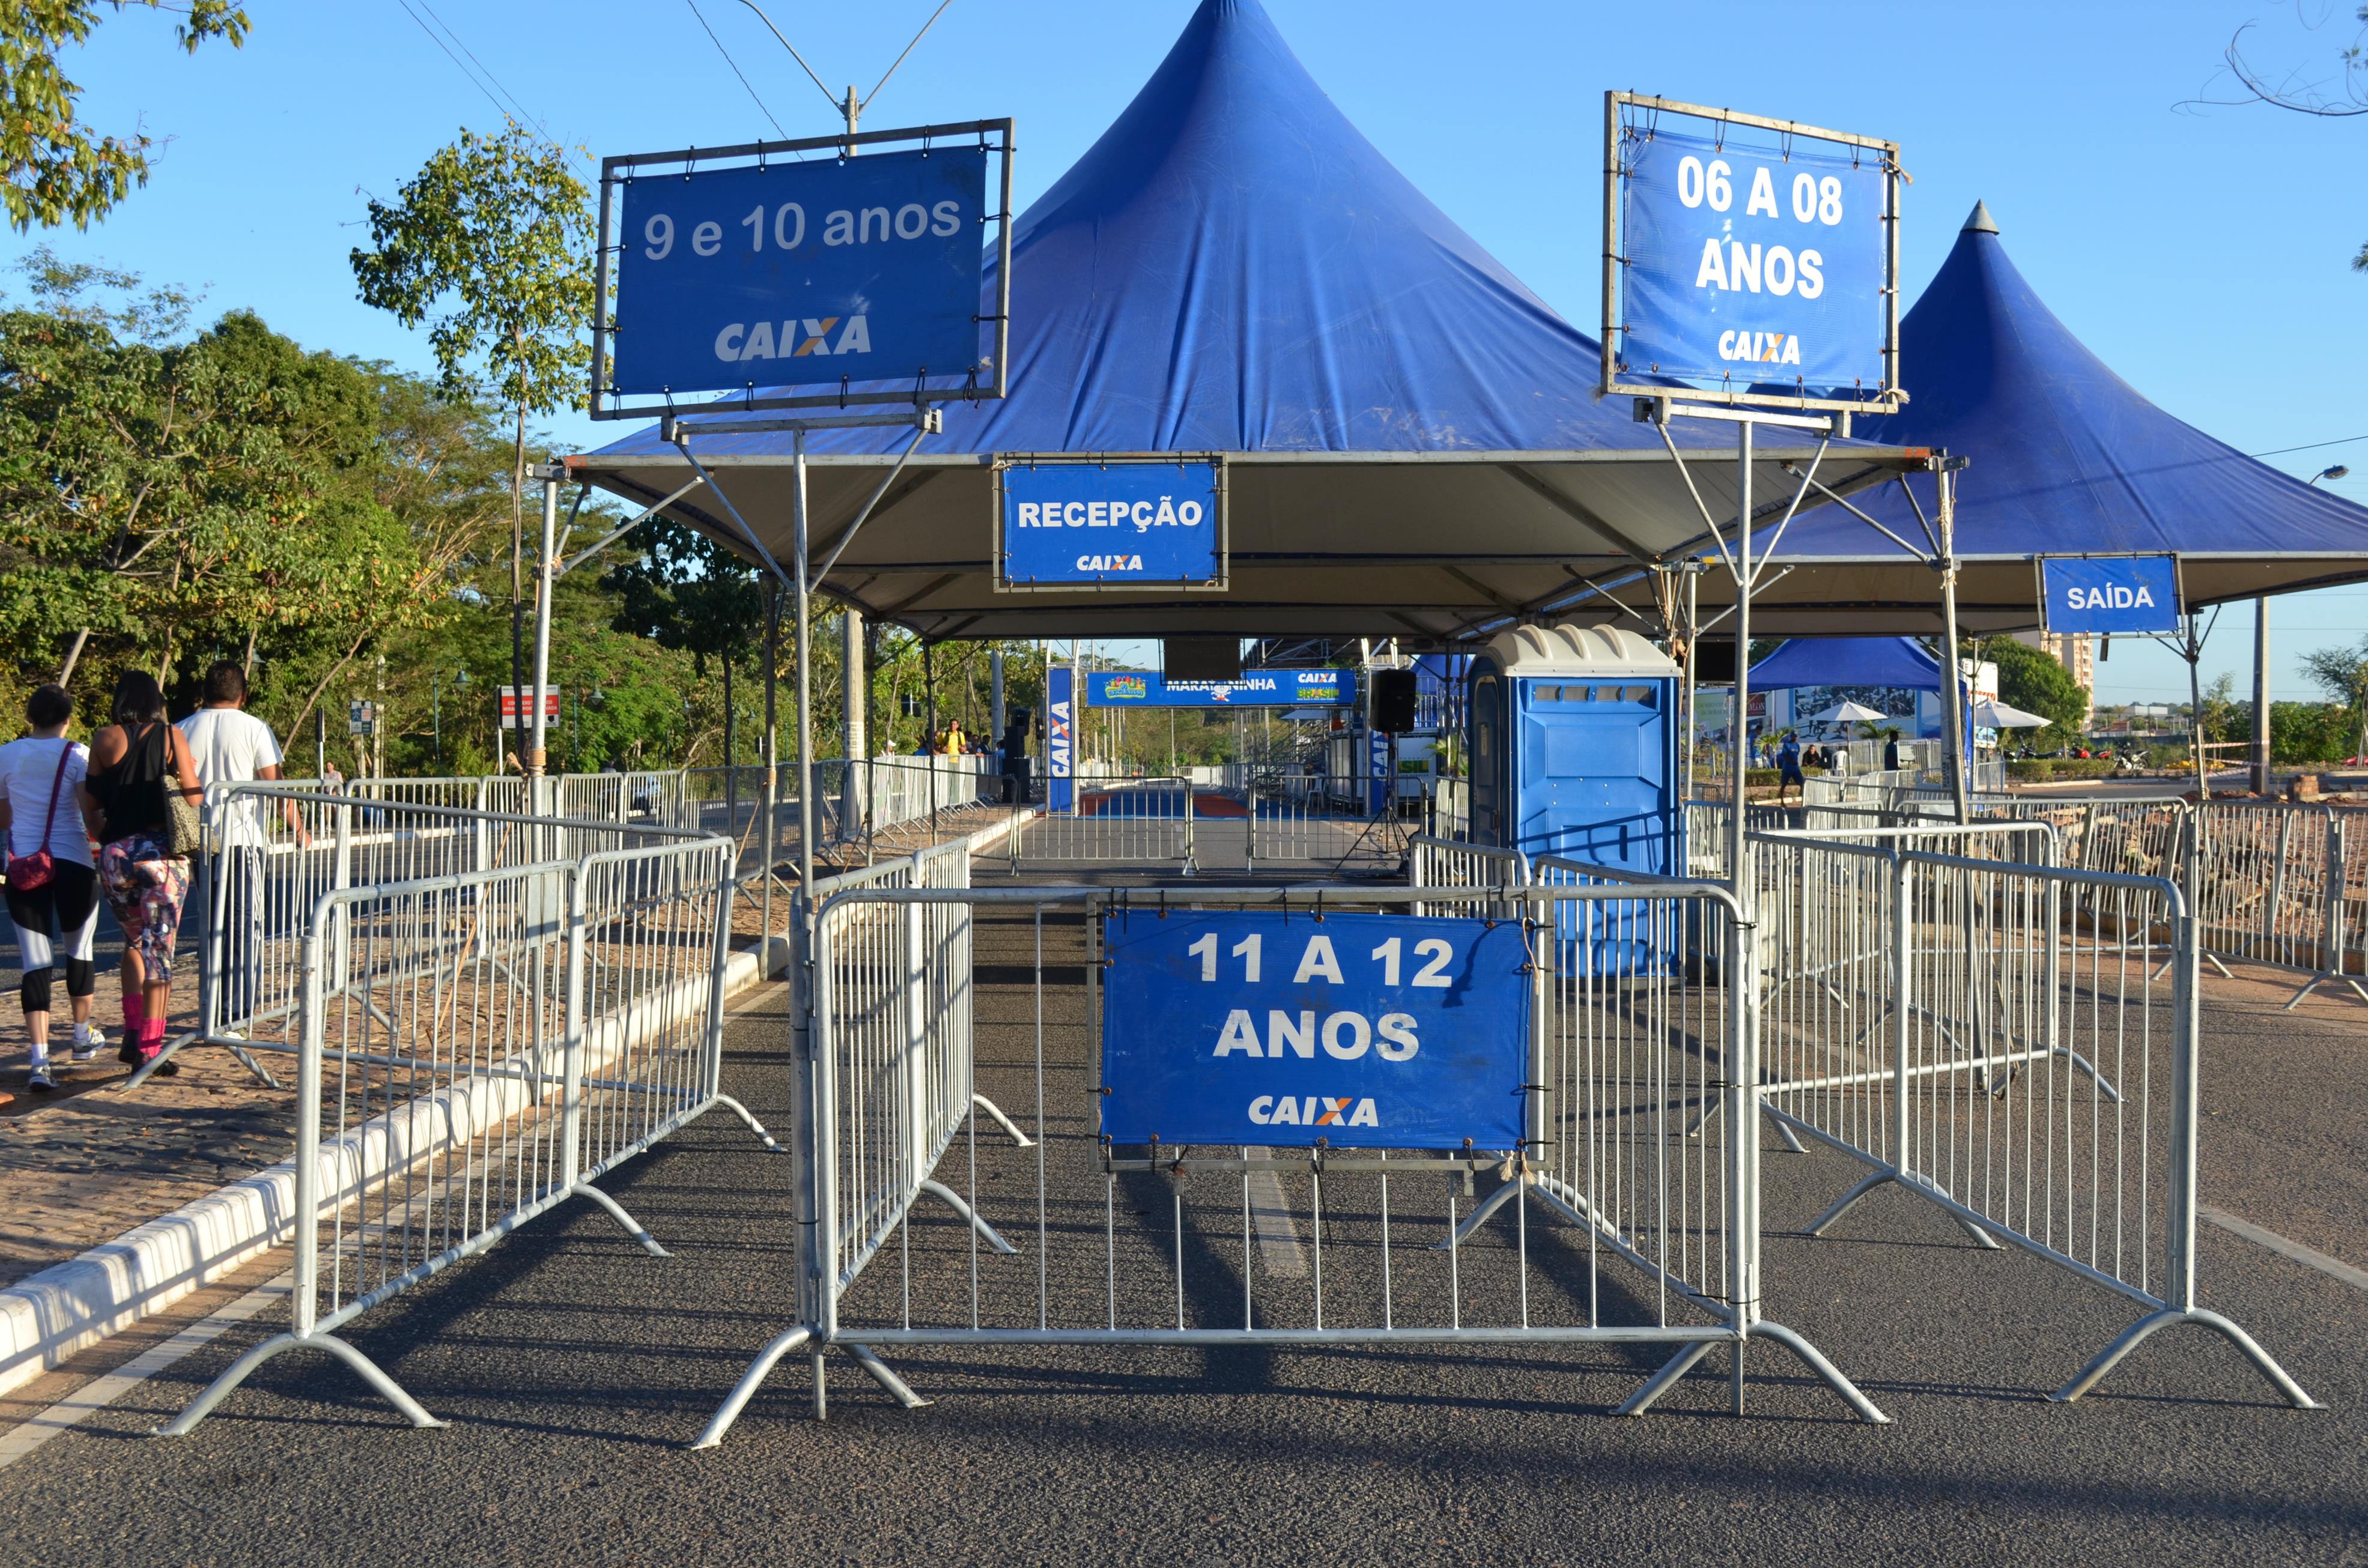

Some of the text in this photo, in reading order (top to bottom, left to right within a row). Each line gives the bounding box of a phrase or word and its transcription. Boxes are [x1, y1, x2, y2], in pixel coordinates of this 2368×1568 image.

[1678, 156, 1842, 226] 06 A 08
[645, 201, 961, 260] 9 e 10 anos
[715, 315, 871, 362] CAIXA
[1719, 330, 1800, 365] CAIXA
[1019, 495, 1202, 533] RECEPÇÃO
[1076, 555, 1143, 571] CAIXA
[2068, 582, 2155, 610] SAÍDA
[1167, 678, 1277, 691] MARATNINHA
[1297, 688, 1339, 698] BRASIL
[1298, 673, 1337, 683] CAIXA
[1052, 701, 1069, 778] CAIXA
[1189, 933, 1453, 987] 11 A 12
[1213, 1009, 1420, 1062] ANOS
[1248, 1095, 1379, 1127] CAIXA
